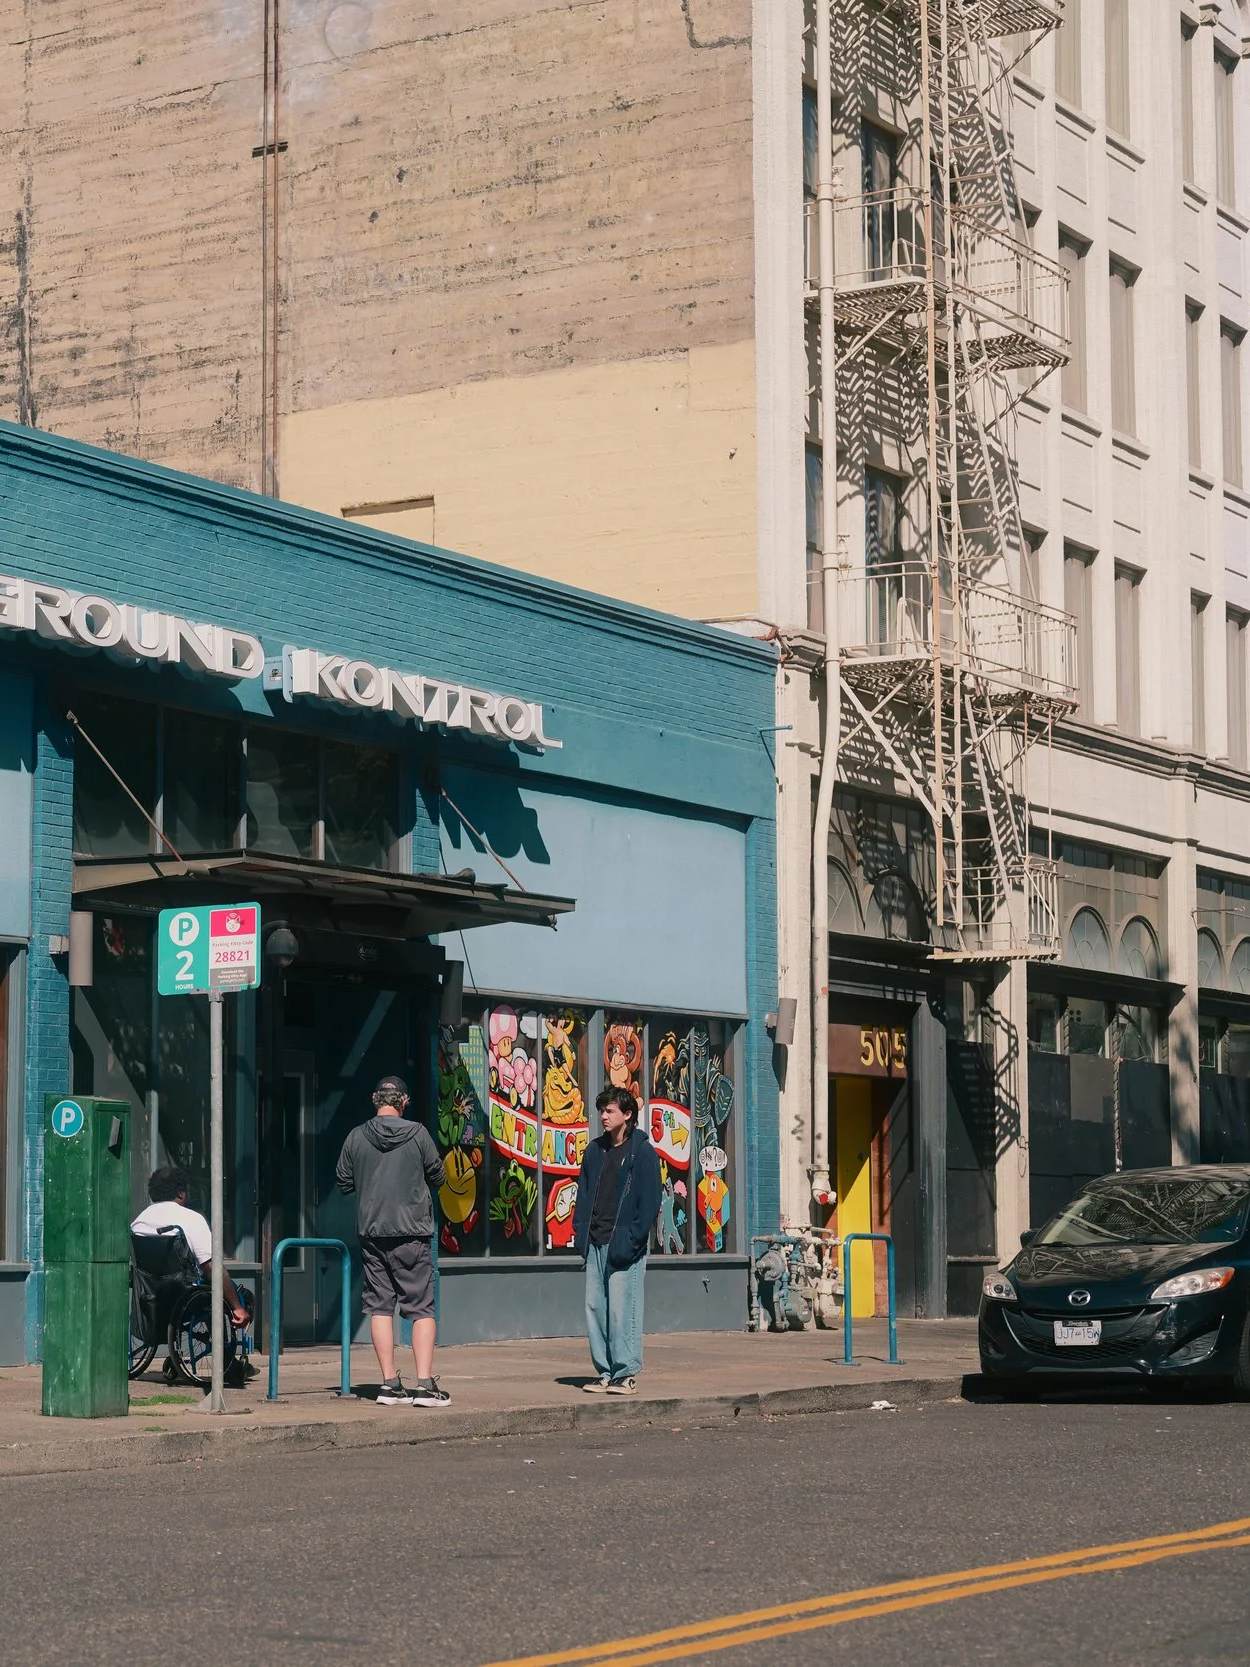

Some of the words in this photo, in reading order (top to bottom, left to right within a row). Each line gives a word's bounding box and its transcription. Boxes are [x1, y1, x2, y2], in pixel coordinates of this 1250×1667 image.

[292, 647, 564, 749] KONTROL
[175, 950, 195, 981] 2
[215, 949, 250, 963] 28821
[860, 1024, 906, 1069] 505
[60, 1107, 76, 1132] P
[491, 1102, 589, 1167] ENTRANCE
[651, 1108, 676, 1143] 5th
